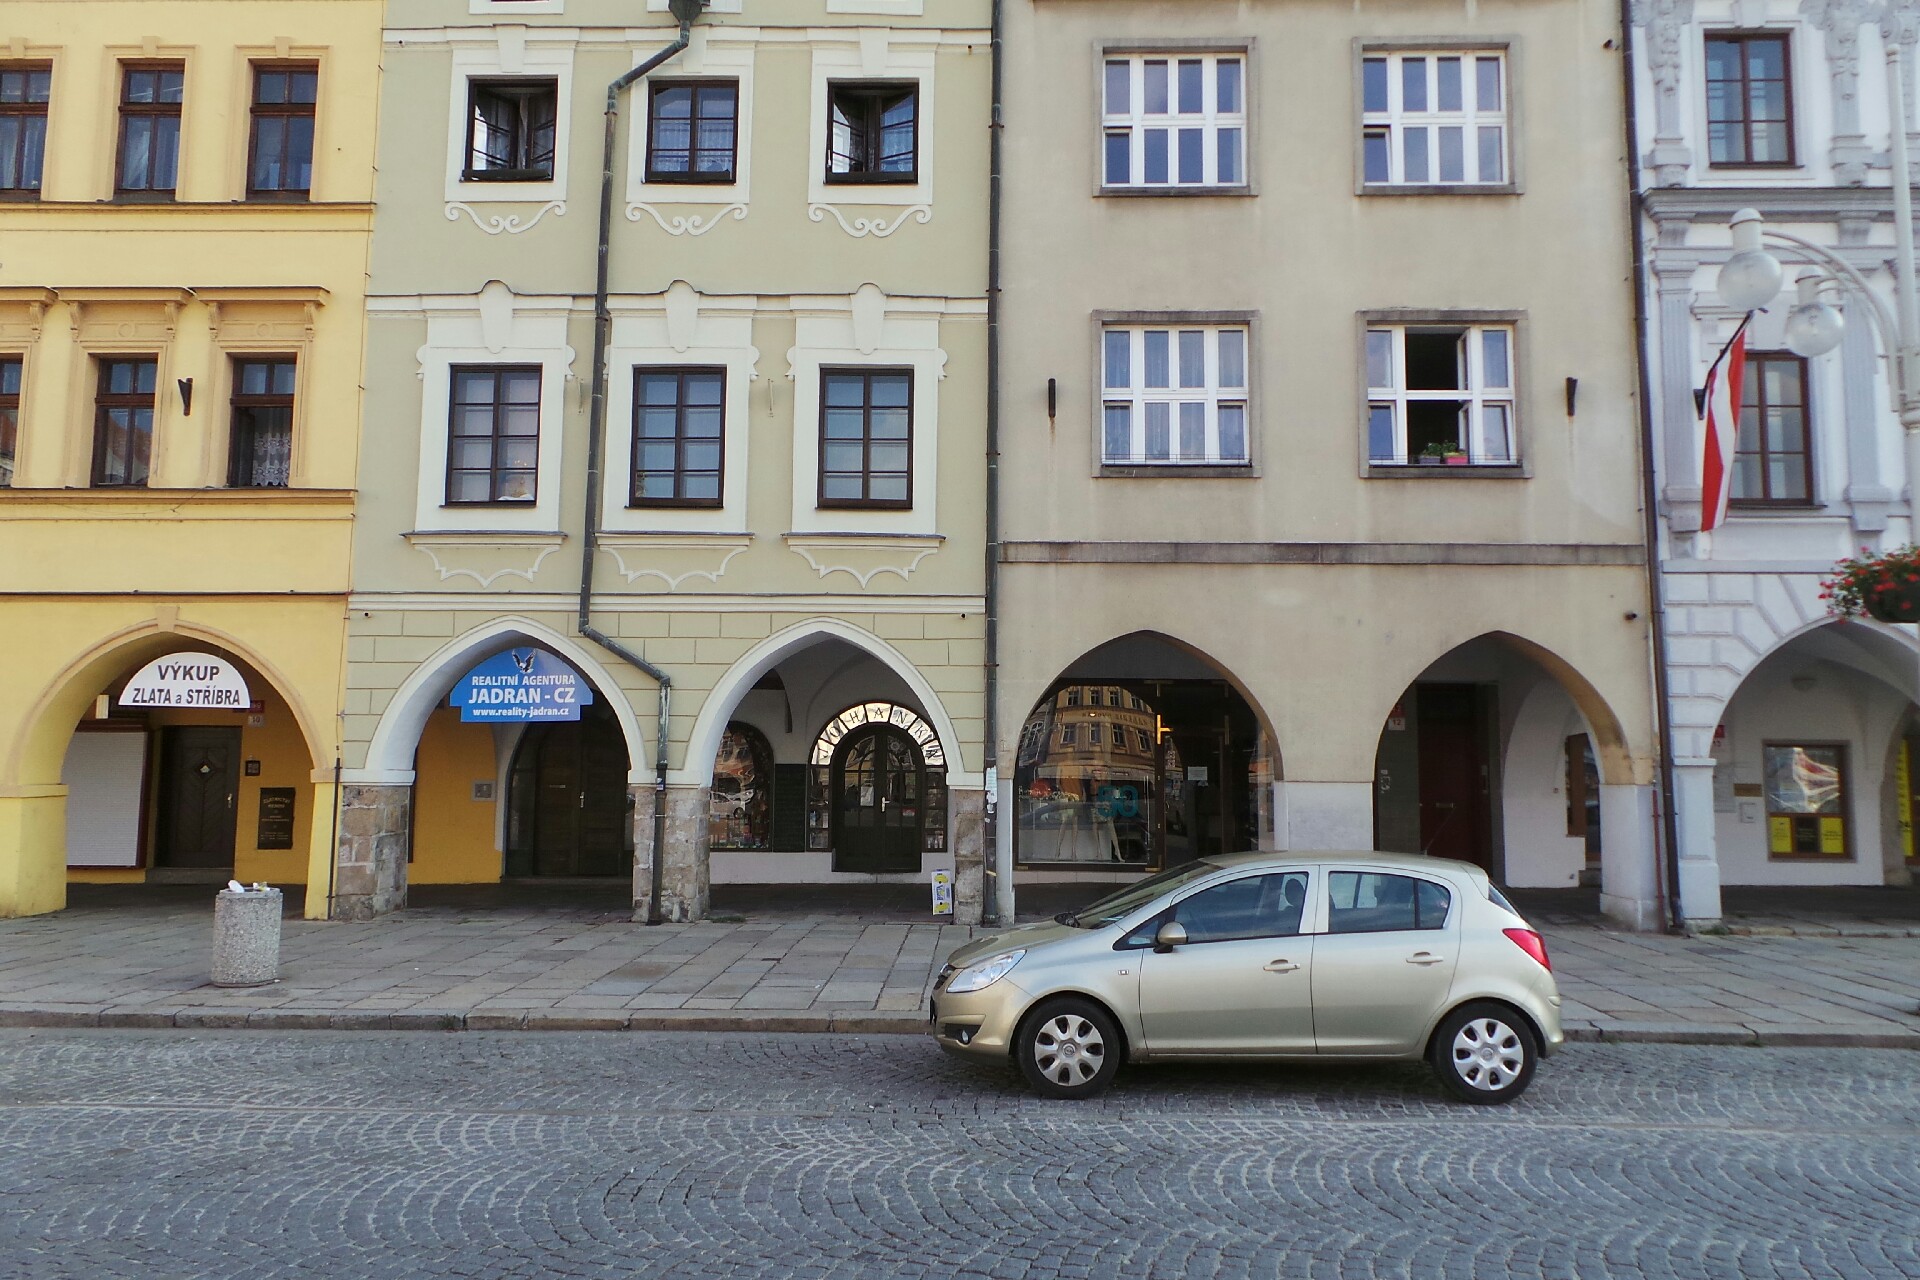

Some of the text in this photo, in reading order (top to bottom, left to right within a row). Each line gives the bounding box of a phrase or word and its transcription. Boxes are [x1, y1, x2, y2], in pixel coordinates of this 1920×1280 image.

[157, 661, 220, 681] VÝKUP
[471, 674, 576, 686] REALITNÍ AGENTURA
[132, 687, 172, 704] ZLATA
[175, 694, 183, 705] a
[186, 685, 241, 706] STŘÍBRA
[468, 688, 541, 704] JADRAN
[553, 687, 576, 703] CZ
[472, 706, 570, 719] www.reality-jadran.cz
[817, 706, 939, 760] JOHANKA
